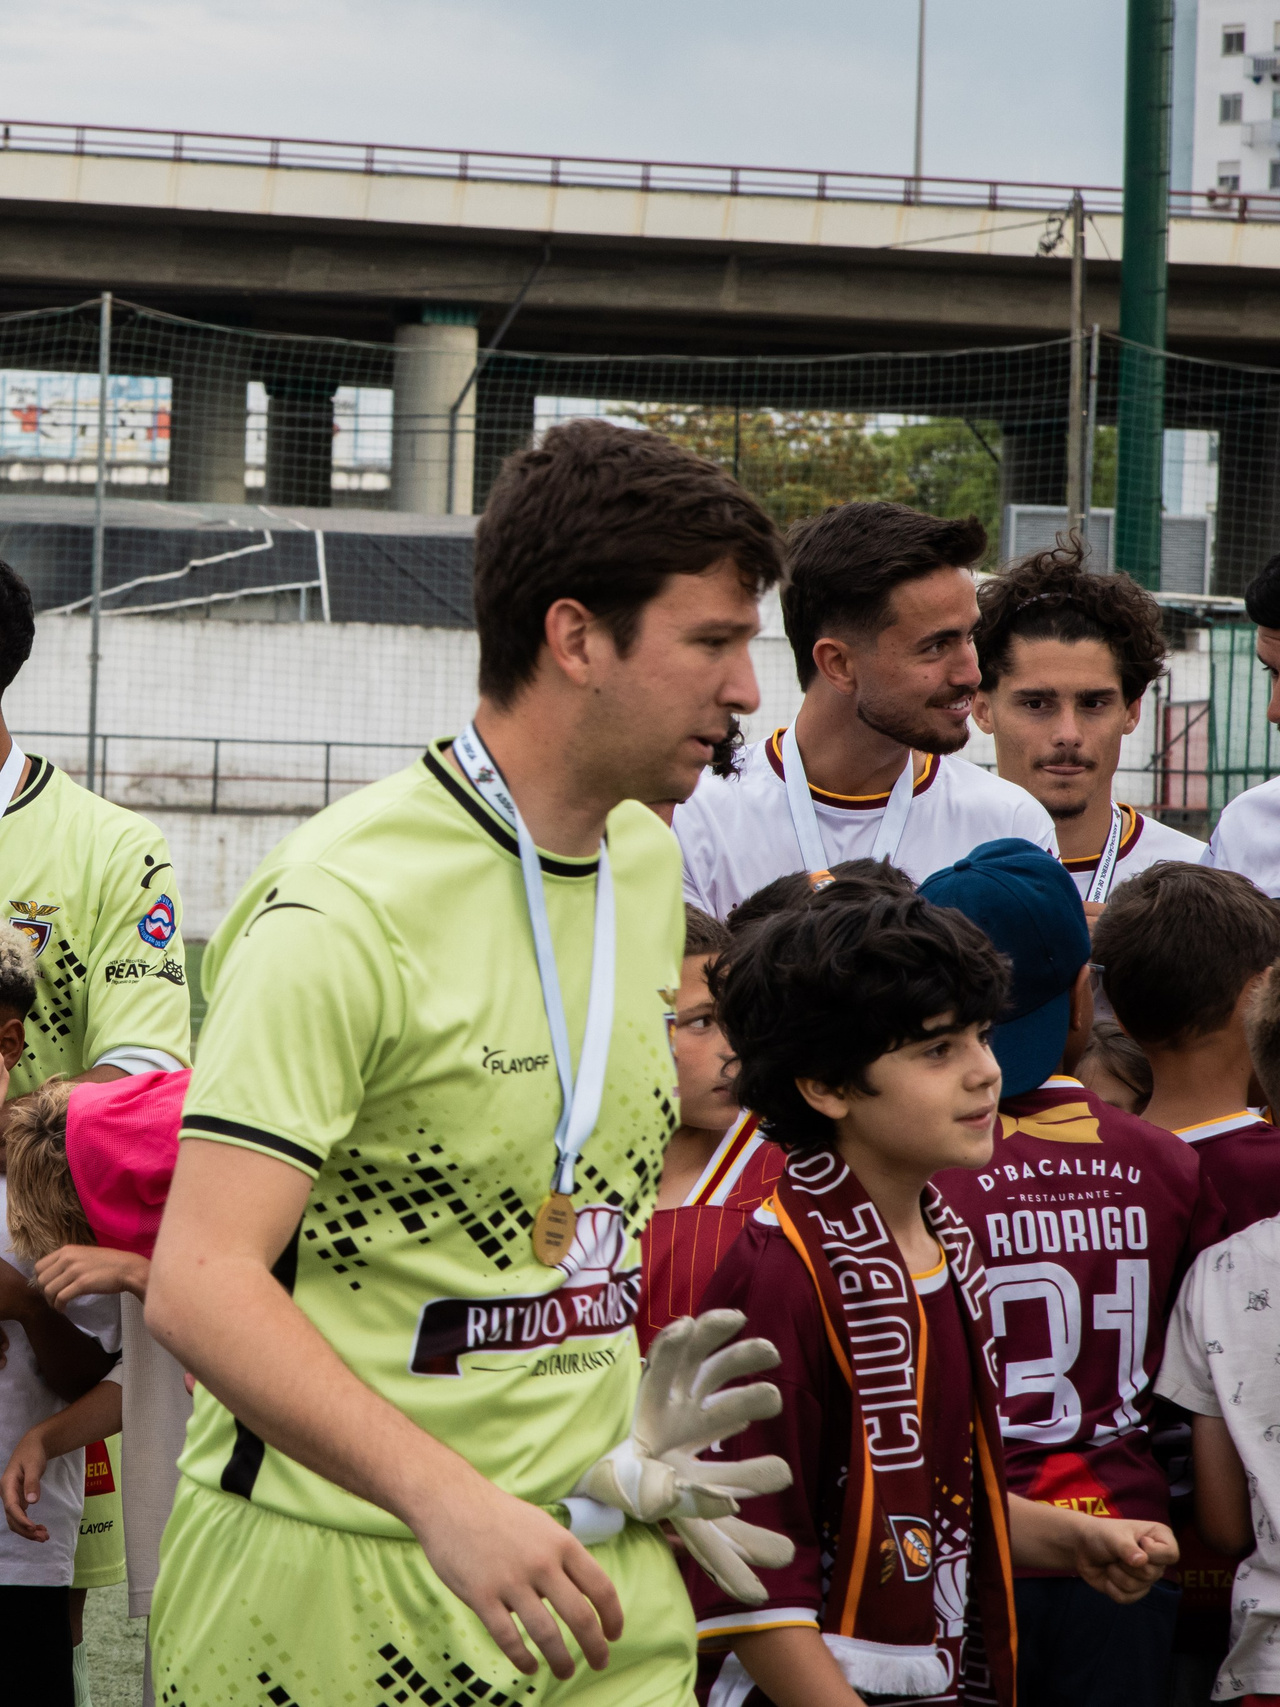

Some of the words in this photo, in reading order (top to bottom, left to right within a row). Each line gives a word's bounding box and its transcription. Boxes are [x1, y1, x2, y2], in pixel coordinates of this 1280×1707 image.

[1093, 887, 1102, 903] LISBO
[491, 1054, 549, 1075] PLAYOFF
[977, 1158, 1141, 1192] D'BACALHAU
[1019, 1189, 1110, 1202] RESTAURANTE
[985, 1205, 1148, 1258] RODRIGO
[984, 1258, 1150, 1447] 31
[84, 1461, 109, 1478] ELTA
[79, 1520, 114, 1535] LAYOFF
